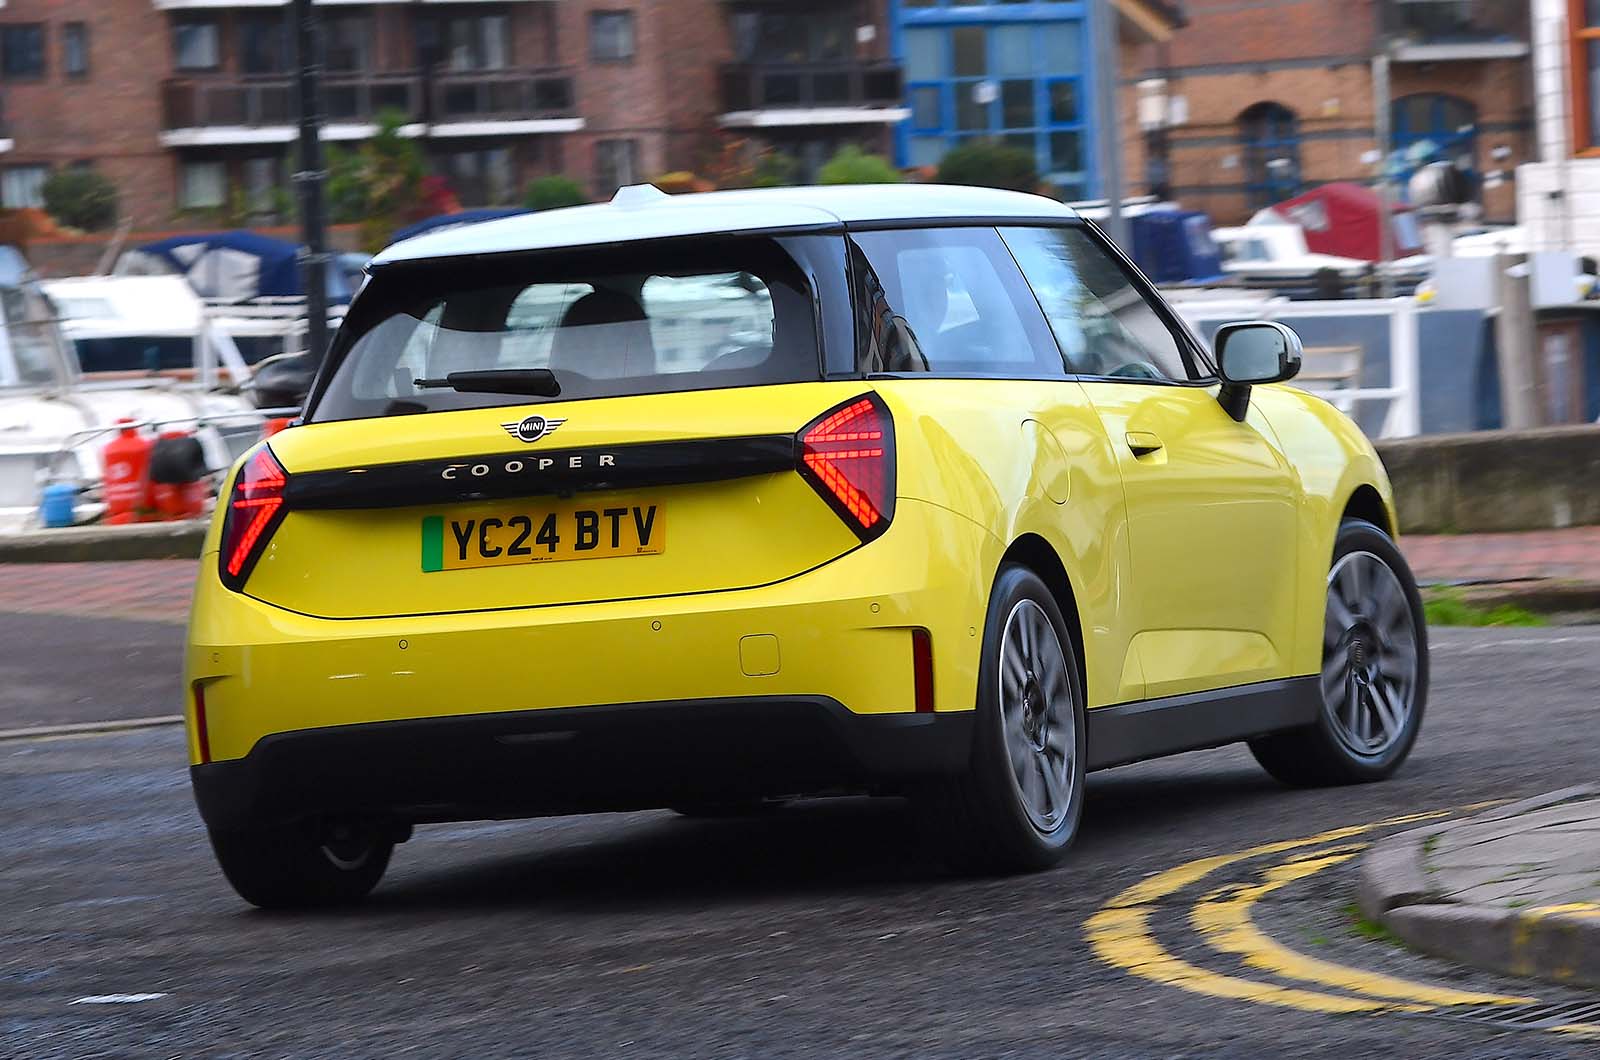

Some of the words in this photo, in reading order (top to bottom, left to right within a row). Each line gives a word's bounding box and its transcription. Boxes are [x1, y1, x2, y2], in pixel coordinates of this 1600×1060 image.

[521, 421, 544, 432] MINI
[441, 455, 616, 480] COOPER
[451, 513, 560, 560] YC24
[574, 505, 657, 551] BTV
